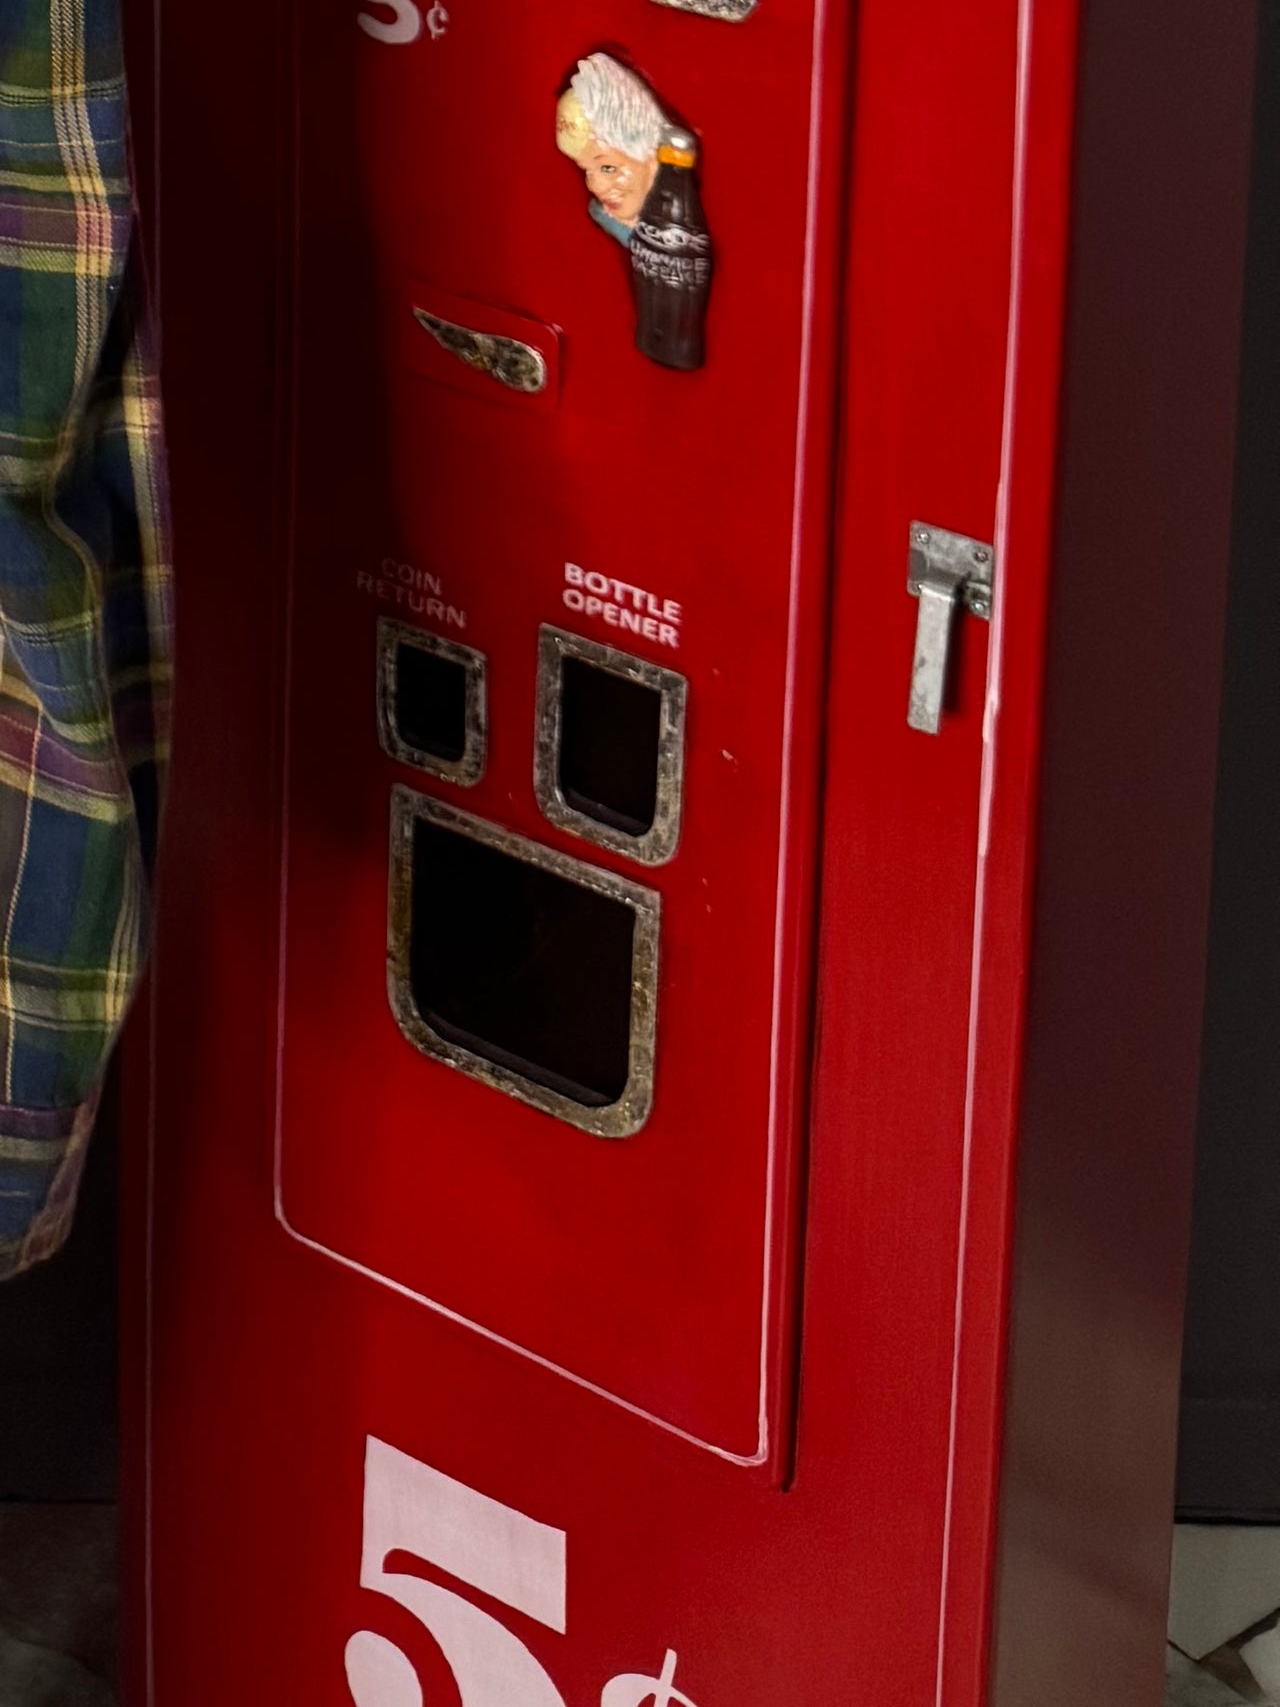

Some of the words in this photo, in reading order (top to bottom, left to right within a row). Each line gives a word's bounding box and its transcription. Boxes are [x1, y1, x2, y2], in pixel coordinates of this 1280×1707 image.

[356, 569, 468, 629] RETURN
[381, 556, 443, 596] COIN
[563, 562, 682, 625] BOTTLE
[560, 588, 680, 649] OPENER
